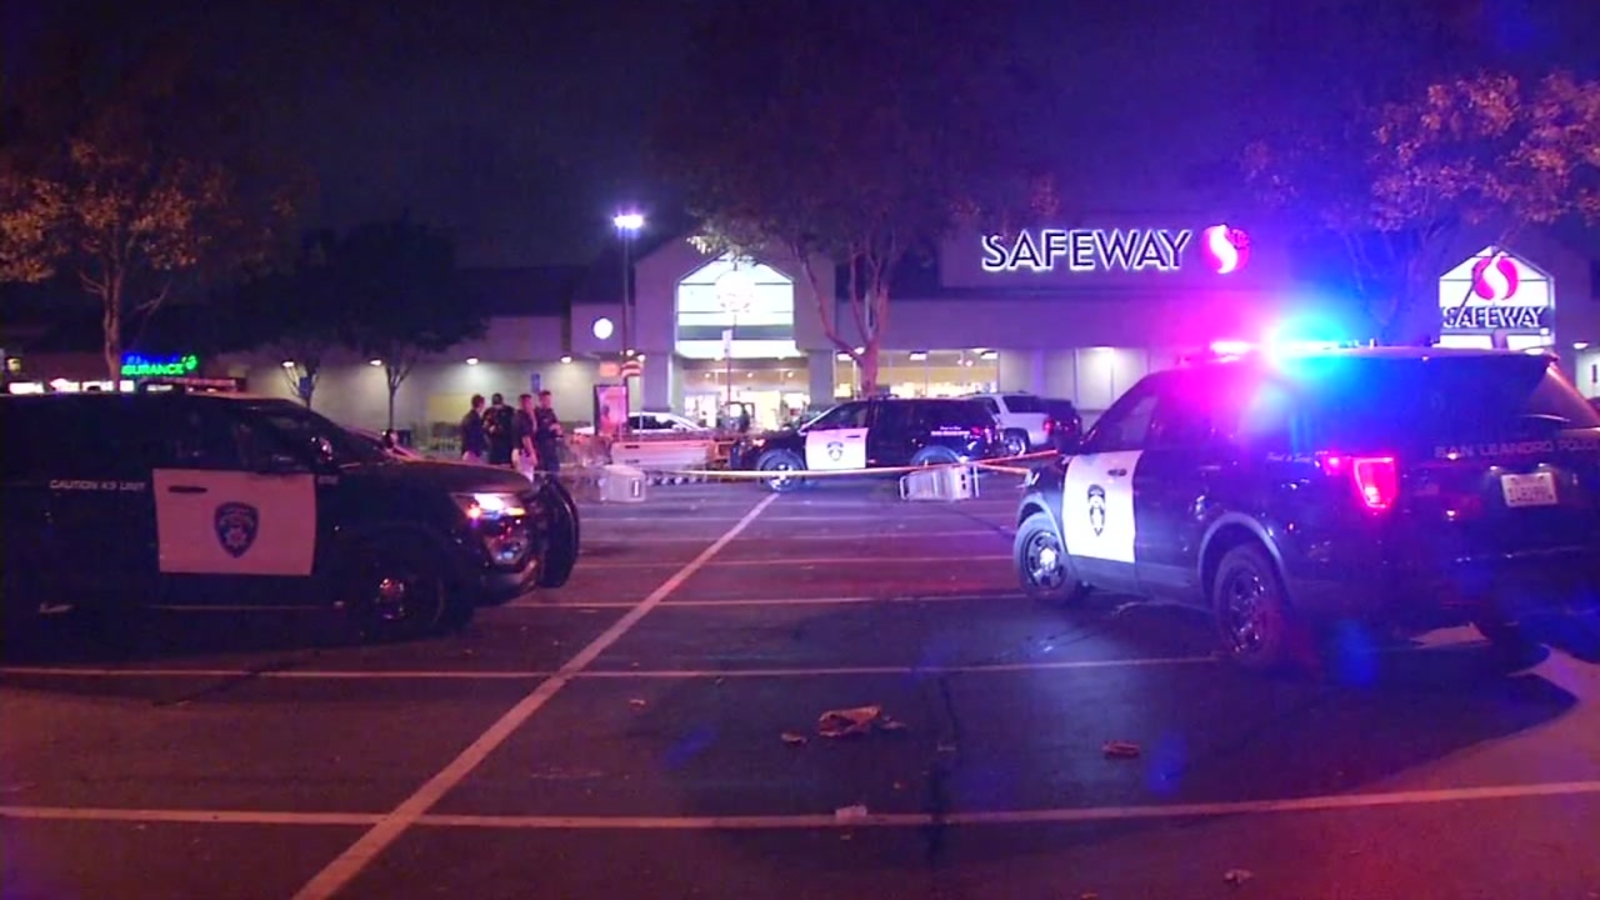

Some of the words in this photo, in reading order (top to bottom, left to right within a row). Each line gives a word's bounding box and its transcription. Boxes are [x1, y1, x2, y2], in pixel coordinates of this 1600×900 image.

[981, 228, 1193, 272] SAFEWAY
[1442, 306, 1546, 329] SAFEWAY
[49, 479, 98, 490] CAUTION
[119, 481, 146, 492] UNIT
